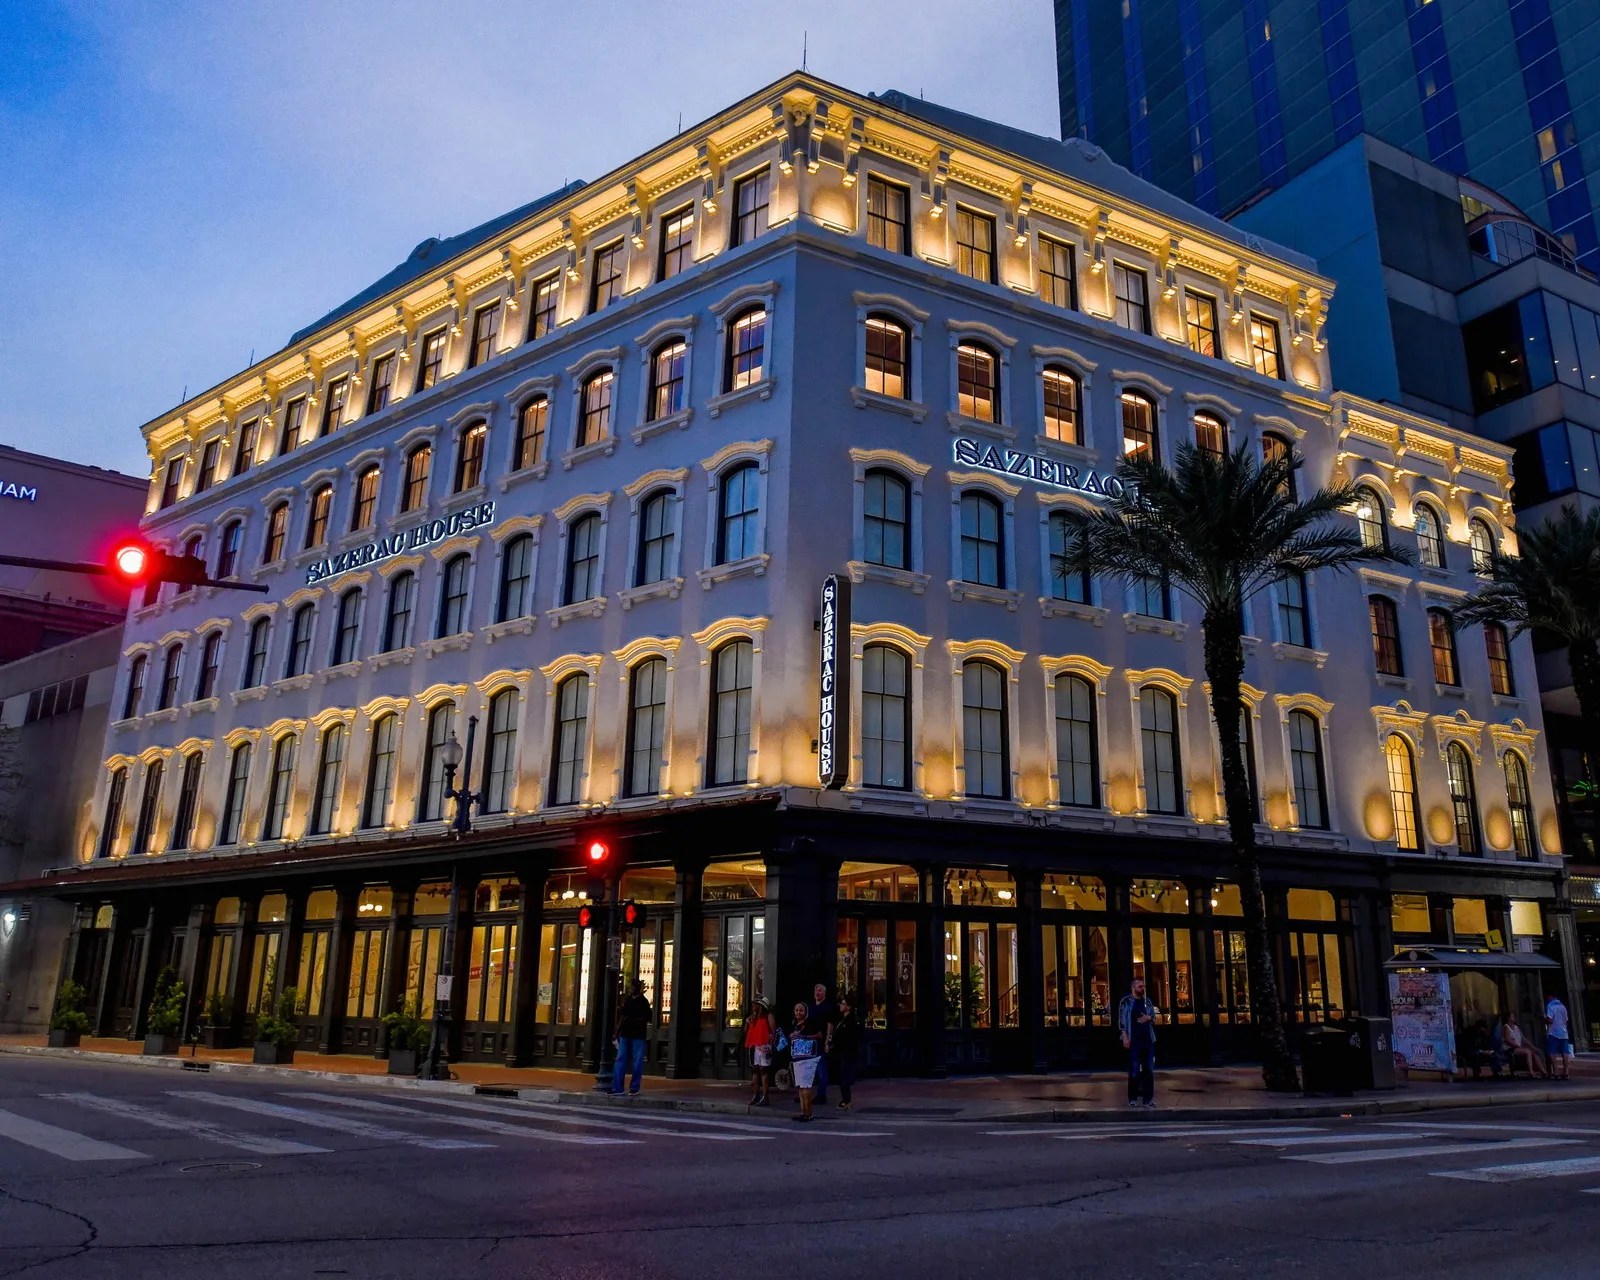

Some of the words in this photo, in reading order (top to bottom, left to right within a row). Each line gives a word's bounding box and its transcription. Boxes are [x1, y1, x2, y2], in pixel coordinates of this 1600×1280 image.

[0, 481, 37, 501] AM
[953, 437, 1126, 500] SAZERAC
[306, 532, 407, 584] SAZERAC
[408, 501, 496, 550] HOUSE
[821, 586, 835, 692] SAZERAC
[820, 695, 833, 776] HOUSE
[867, 936, 886, 944] SAVOR
[869, 952, 884, 960] DATE
